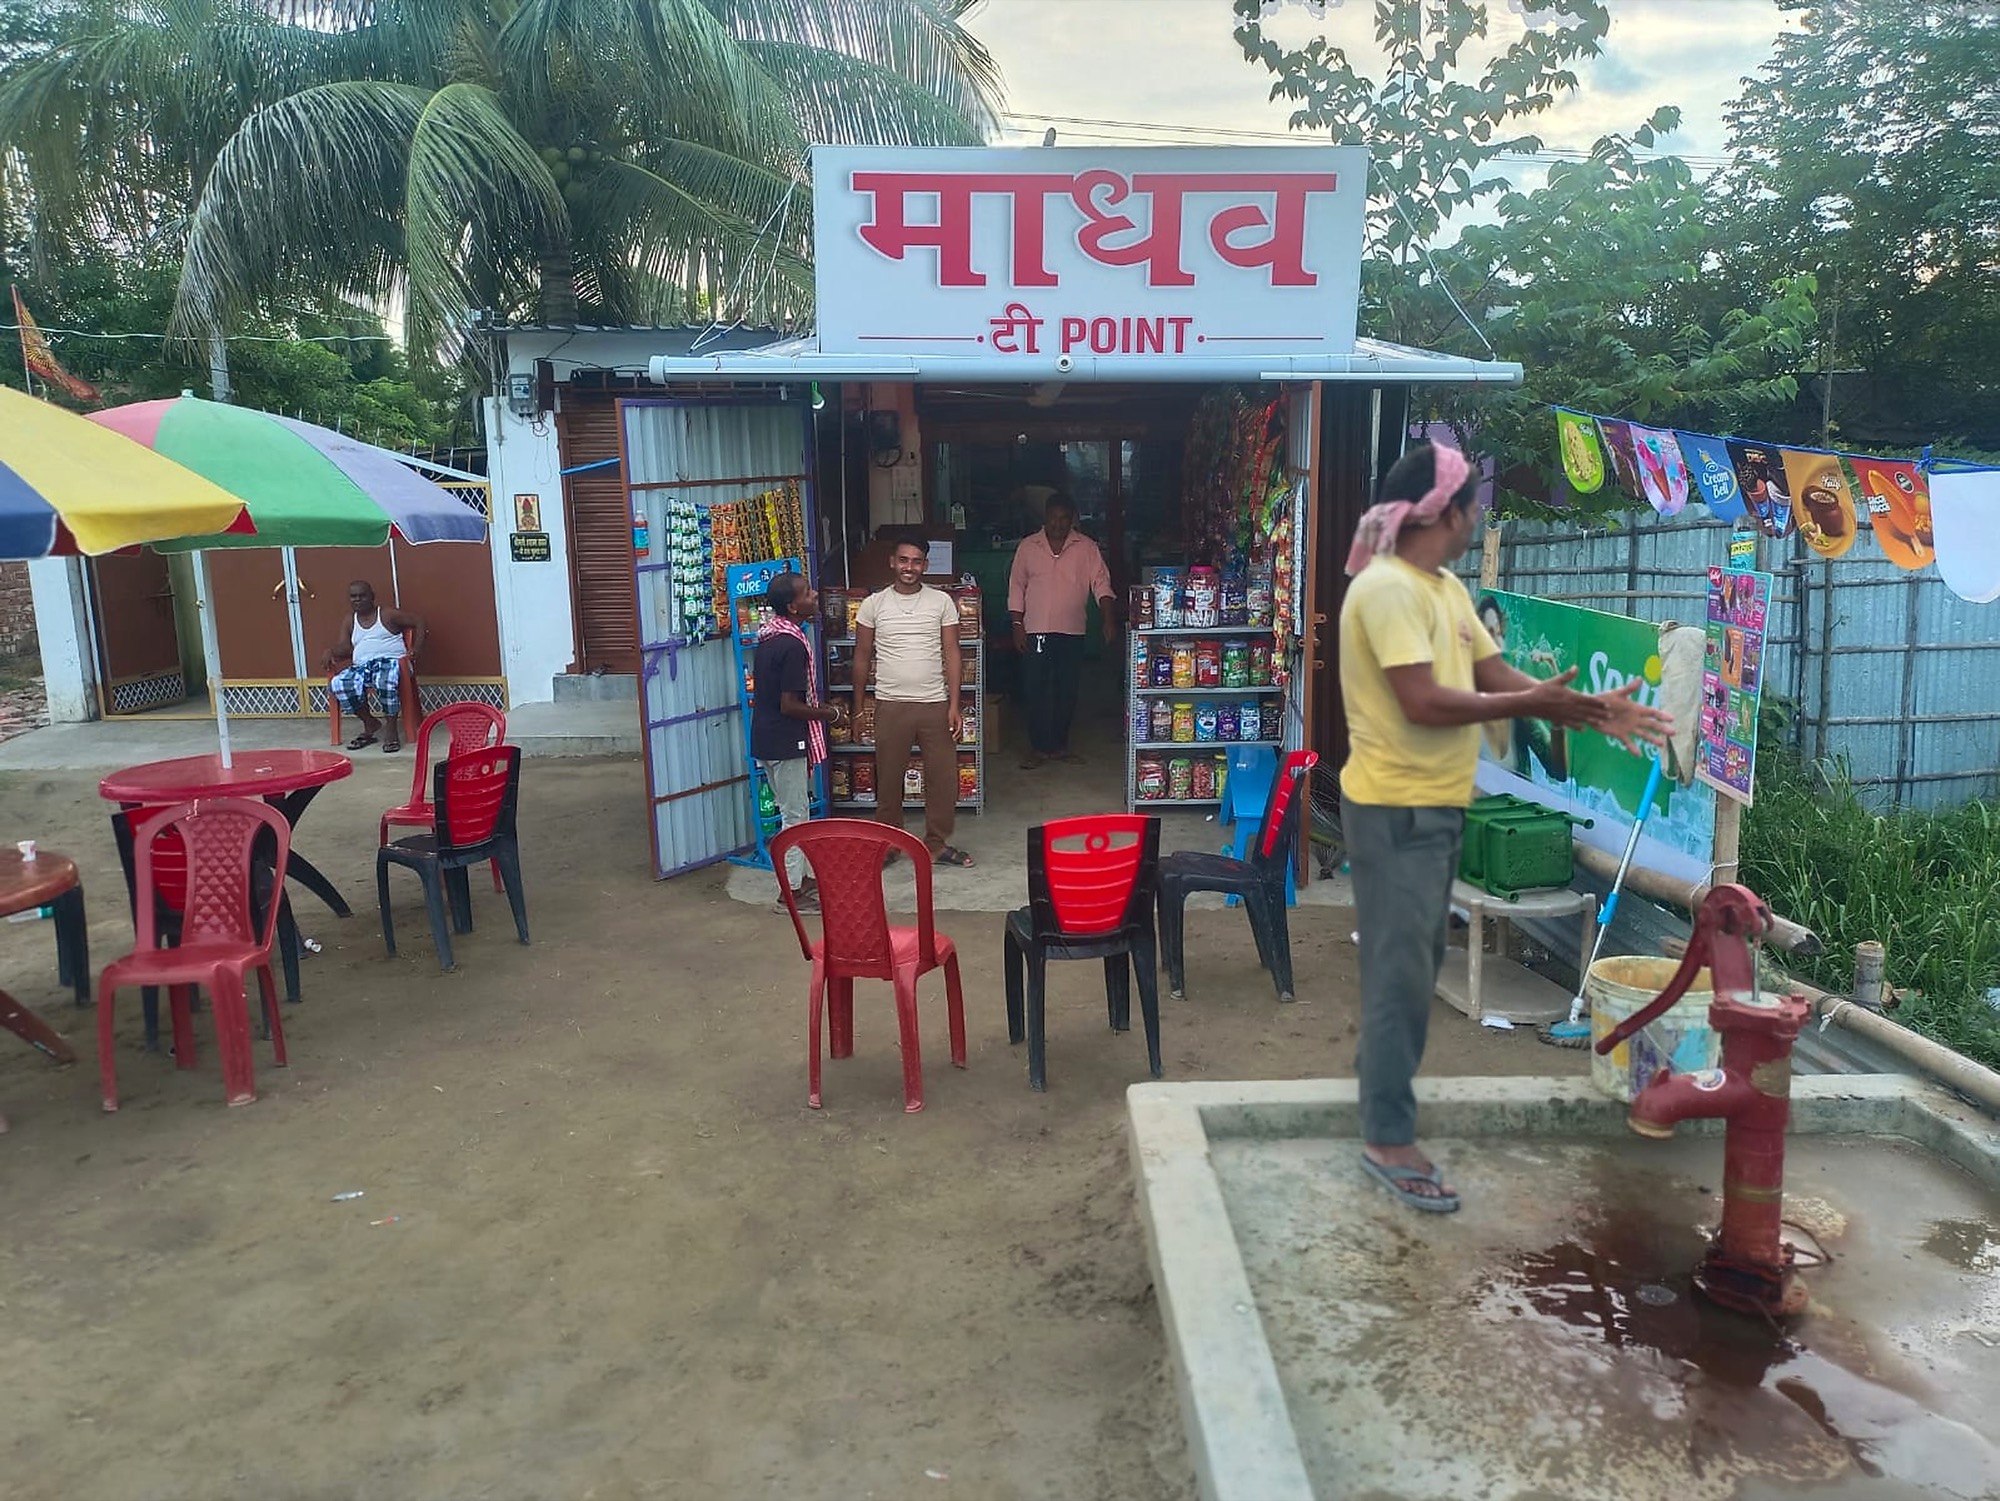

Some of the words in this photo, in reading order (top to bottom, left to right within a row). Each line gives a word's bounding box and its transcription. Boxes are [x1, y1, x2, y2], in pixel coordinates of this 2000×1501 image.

[852, 170, 1337, 287] माधव
[990, 303, 1044, 353] टी
[1062, 317, 1193, 353] POINT
[1702, 472, 1730, 486] Cream
[1712, 484, 1730, 499] Bell
[736, 580, 762, 594] SURE
